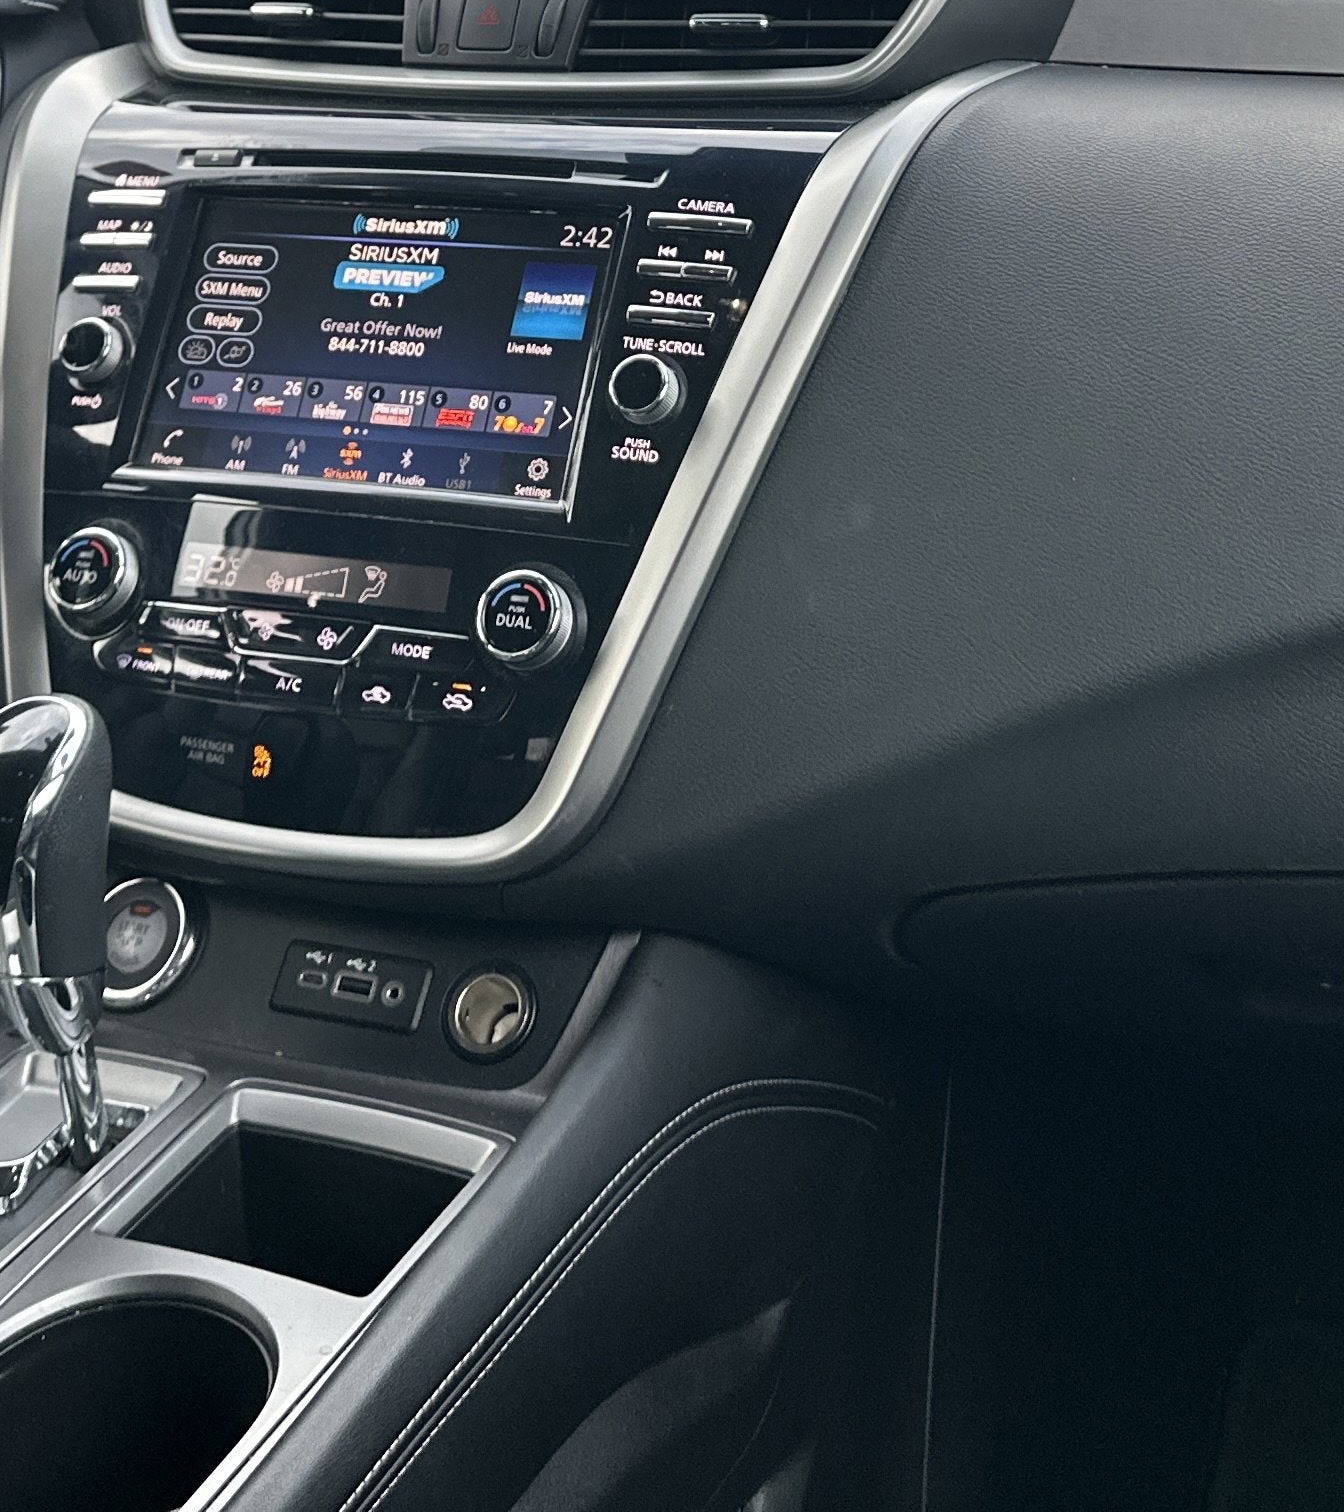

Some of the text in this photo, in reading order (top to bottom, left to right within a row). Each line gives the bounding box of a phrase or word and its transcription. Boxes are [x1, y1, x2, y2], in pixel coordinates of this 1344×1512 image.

[677, 198, 735, 215] CAMERA
[97, 219, 123, 231] MAP
[559, 225, 613, 249] 2:42
[217, 250, 263, 267] Source
[348, 243, 440, 265] SIRIUSXM
[98, 262, 133, 274] AUDIO
[342, 267, 435, 288] PREVIEW
[201, 280, 264, 298] SXM Menu
[369, 292, 405, 308] Ch. 1
[523, 291, 586, 306] SiriusXM
[665, 292, 703, 307] BACK
[102, 304, 122, 317] VOL
[204, 311, 244, 331] Replay
[320, 317, 444, 340] Great Offer Now!
[328, 336, 425, 357] 844-711-8800
[506, 341, 553, 356] Live Mode
[232, 376, 244, 392] 2
[282, 380, 303, 396] 26
[344, 385, 364, 401] 56
[399, 389, 425, 405] 115
[469, 394, 489, 410] 80
[542, 400, 554, 415] 7
[624, 437, 651, 449] PUSH
[151, 453, 184, 465] Phone
[611, 446, 659, 463] SOUND
[225, 459, 246, 471] AM
[281, 463, 299, 475] FM
[323, 467, 368, 481] SiriusXM
[378, 472, 426, 487] BT Audio
[514, 484, 552, 500] Settings
[495, 613, 533, 630] DUAL
[391, 642, 432, 660] MODE
[275, 677, 303, 693] A/C
[180, 735, 234, 753] PASSENGER
